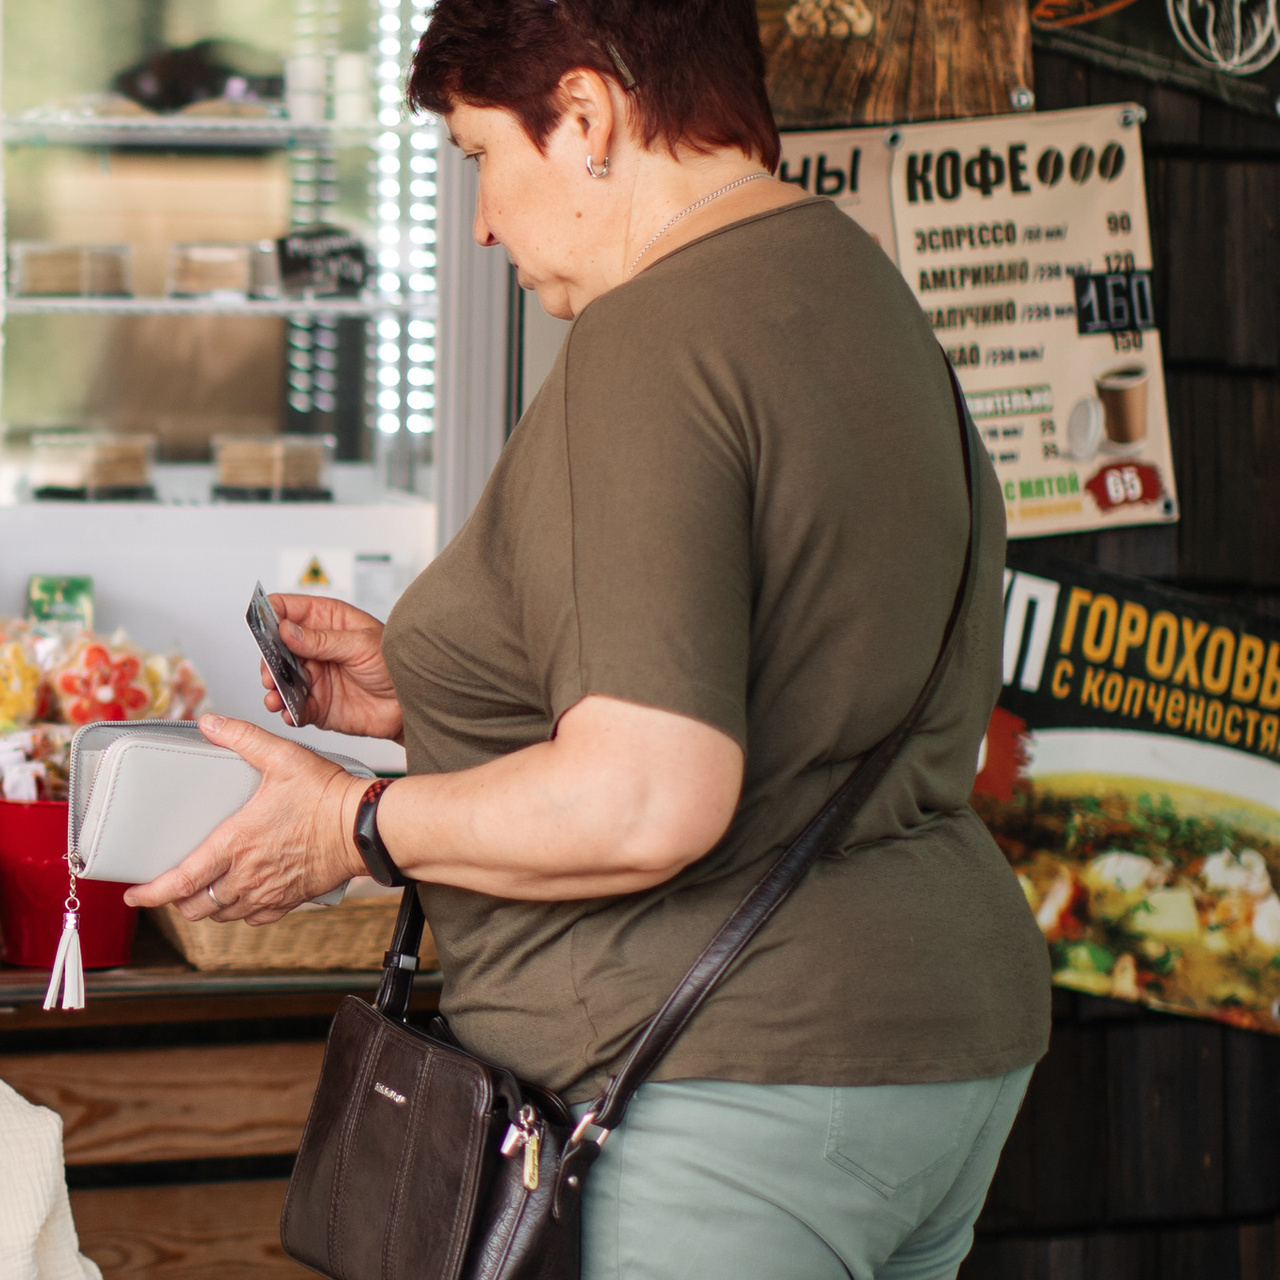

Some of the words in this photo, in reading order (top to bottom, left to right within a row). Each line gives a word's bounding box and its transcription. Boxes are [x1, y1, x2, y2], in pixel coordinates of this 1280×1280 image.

[779, 147, 861, 196] НЫ
[906, 143, 1031, 203] КОФЕ
[914, 221, 1016, 254] ЭСПРЕССО
[919, 259, 1029, 292] АМЕРИКАНО
[1081, 275, 1154, 331] 160
[1019, 470, 1080, 500] МЯТОЙ
[1106, 466, 1142, 505] 65
[1003, 567, 1061, 693] П
